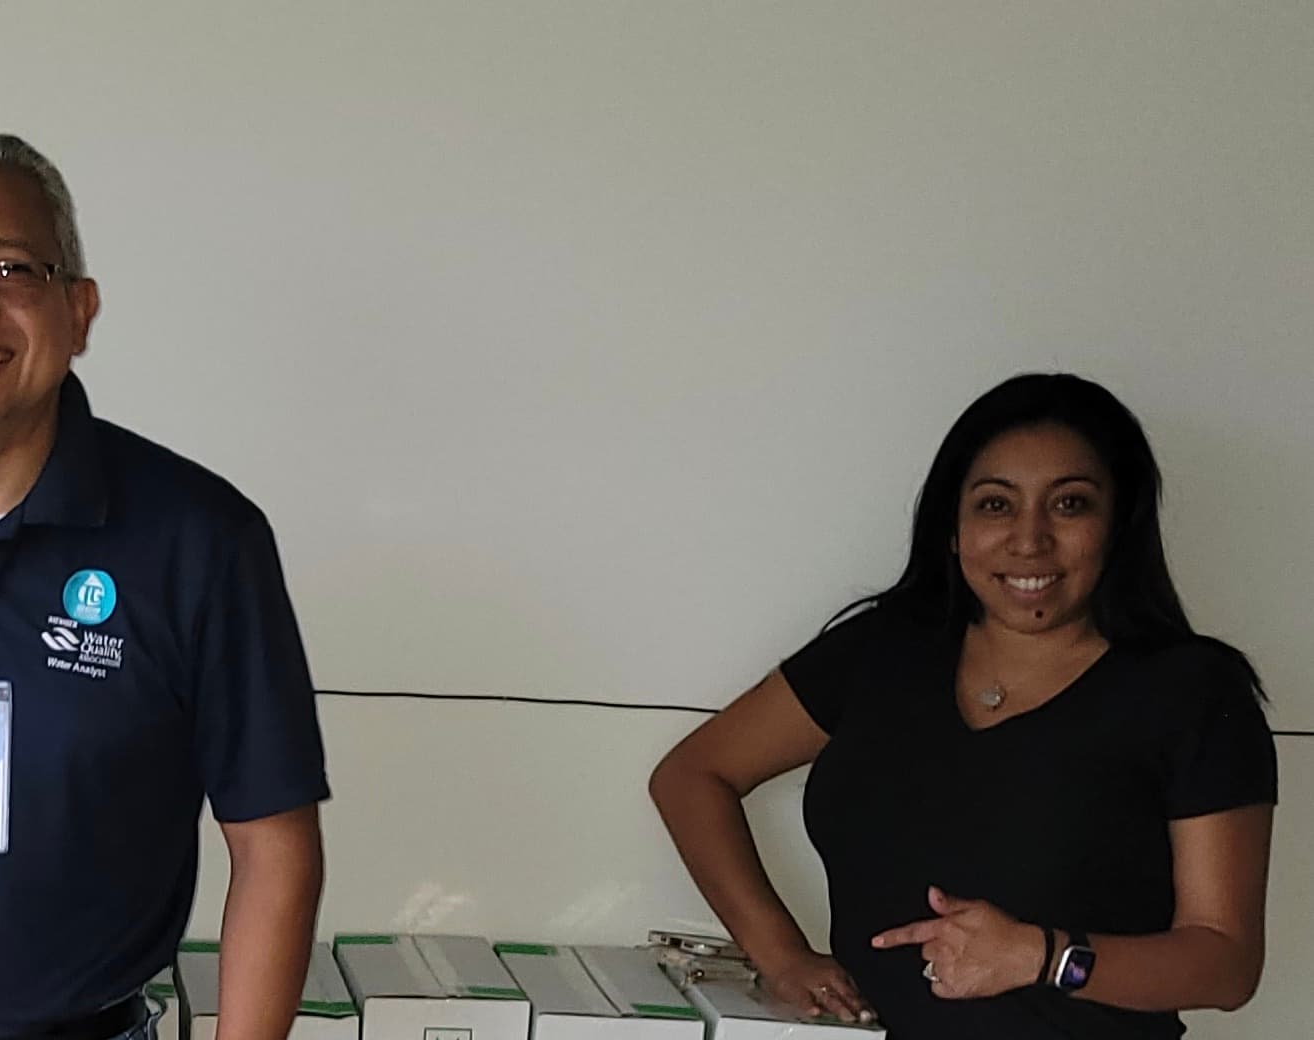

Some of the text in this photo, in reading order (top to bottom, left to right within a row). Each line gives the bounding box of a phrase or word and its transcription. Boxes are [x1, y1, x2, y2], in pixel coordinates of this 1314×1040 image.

[84, 631, 124, 648] Water
[80, 643, 122, 660] Quality
[47, 656, 106, 678] Water Analyst
